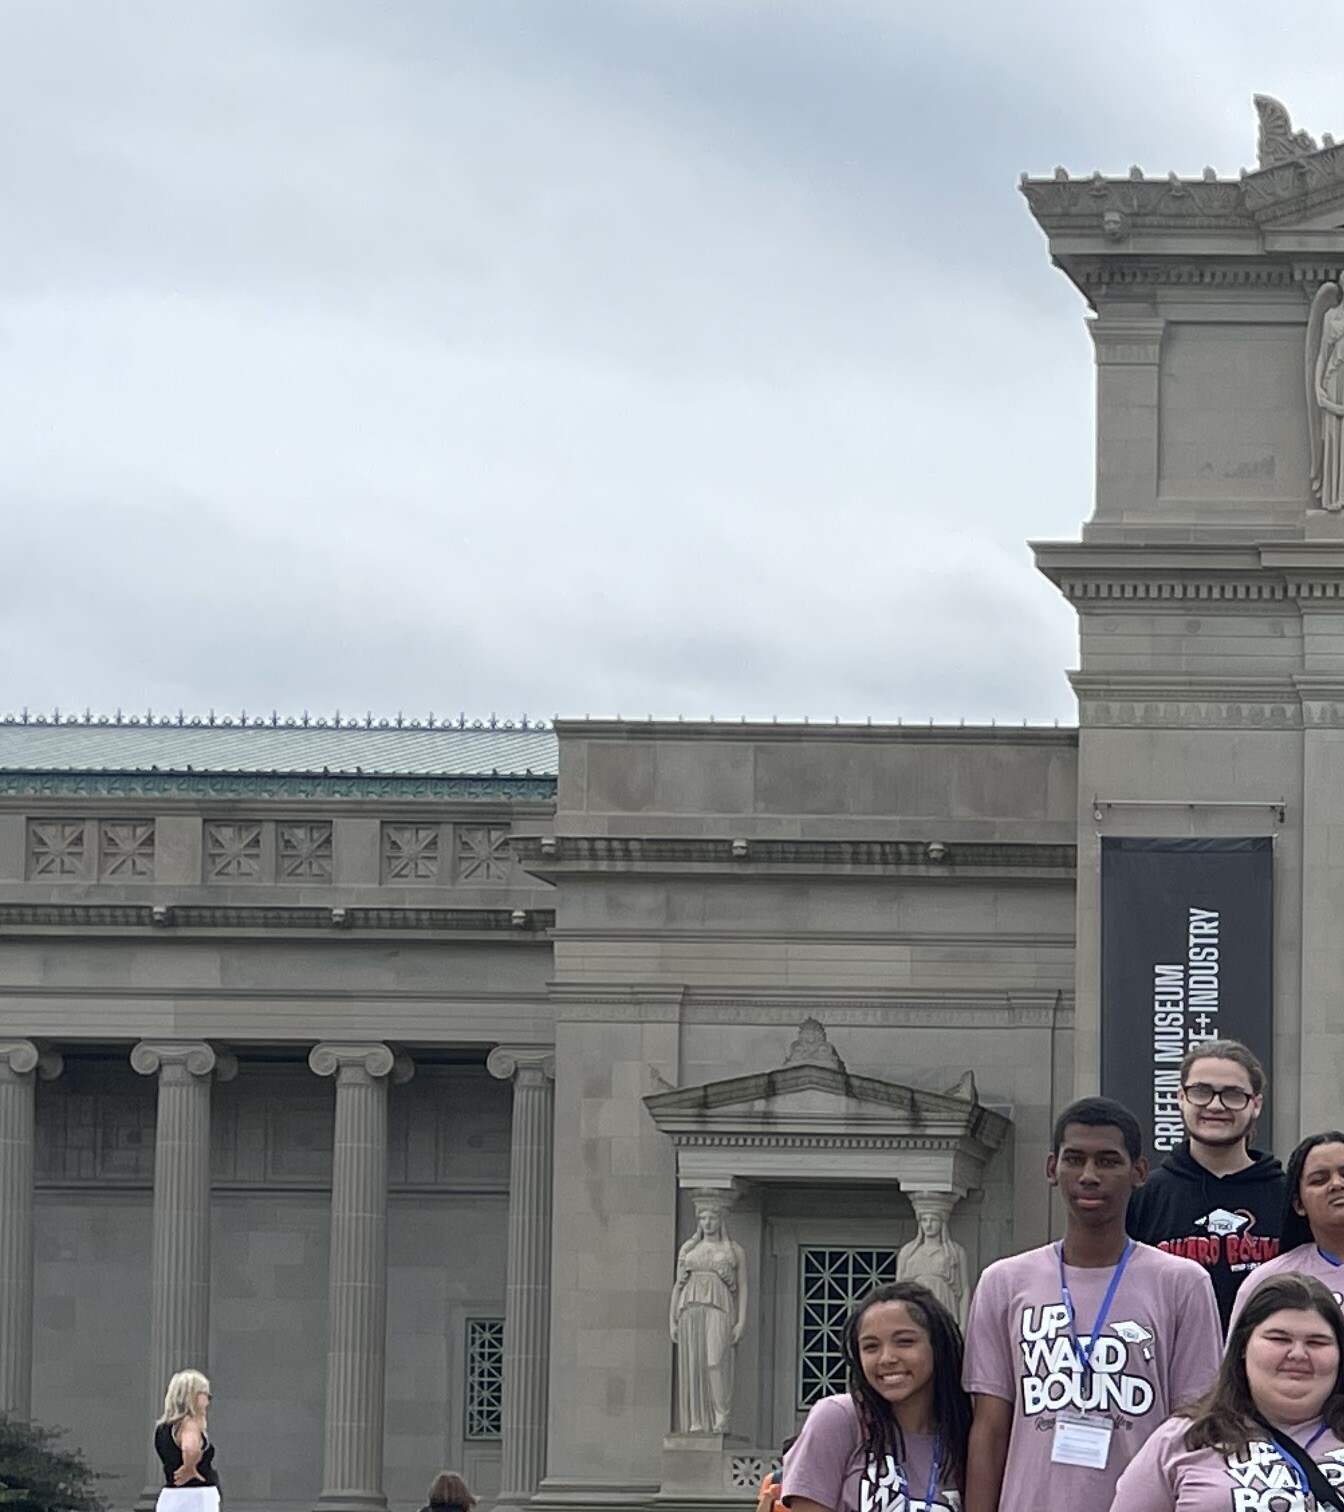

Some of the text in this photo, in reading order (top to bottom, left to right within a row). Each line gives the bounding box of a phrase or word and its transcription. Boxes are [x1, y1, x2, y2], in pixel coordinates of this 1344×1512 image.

[1153, 964, 1185, 1063] MUSEUM
[1022, 1304, 1073, 1340] UP
[1021, 1372, 1154, 1416] BOUND
